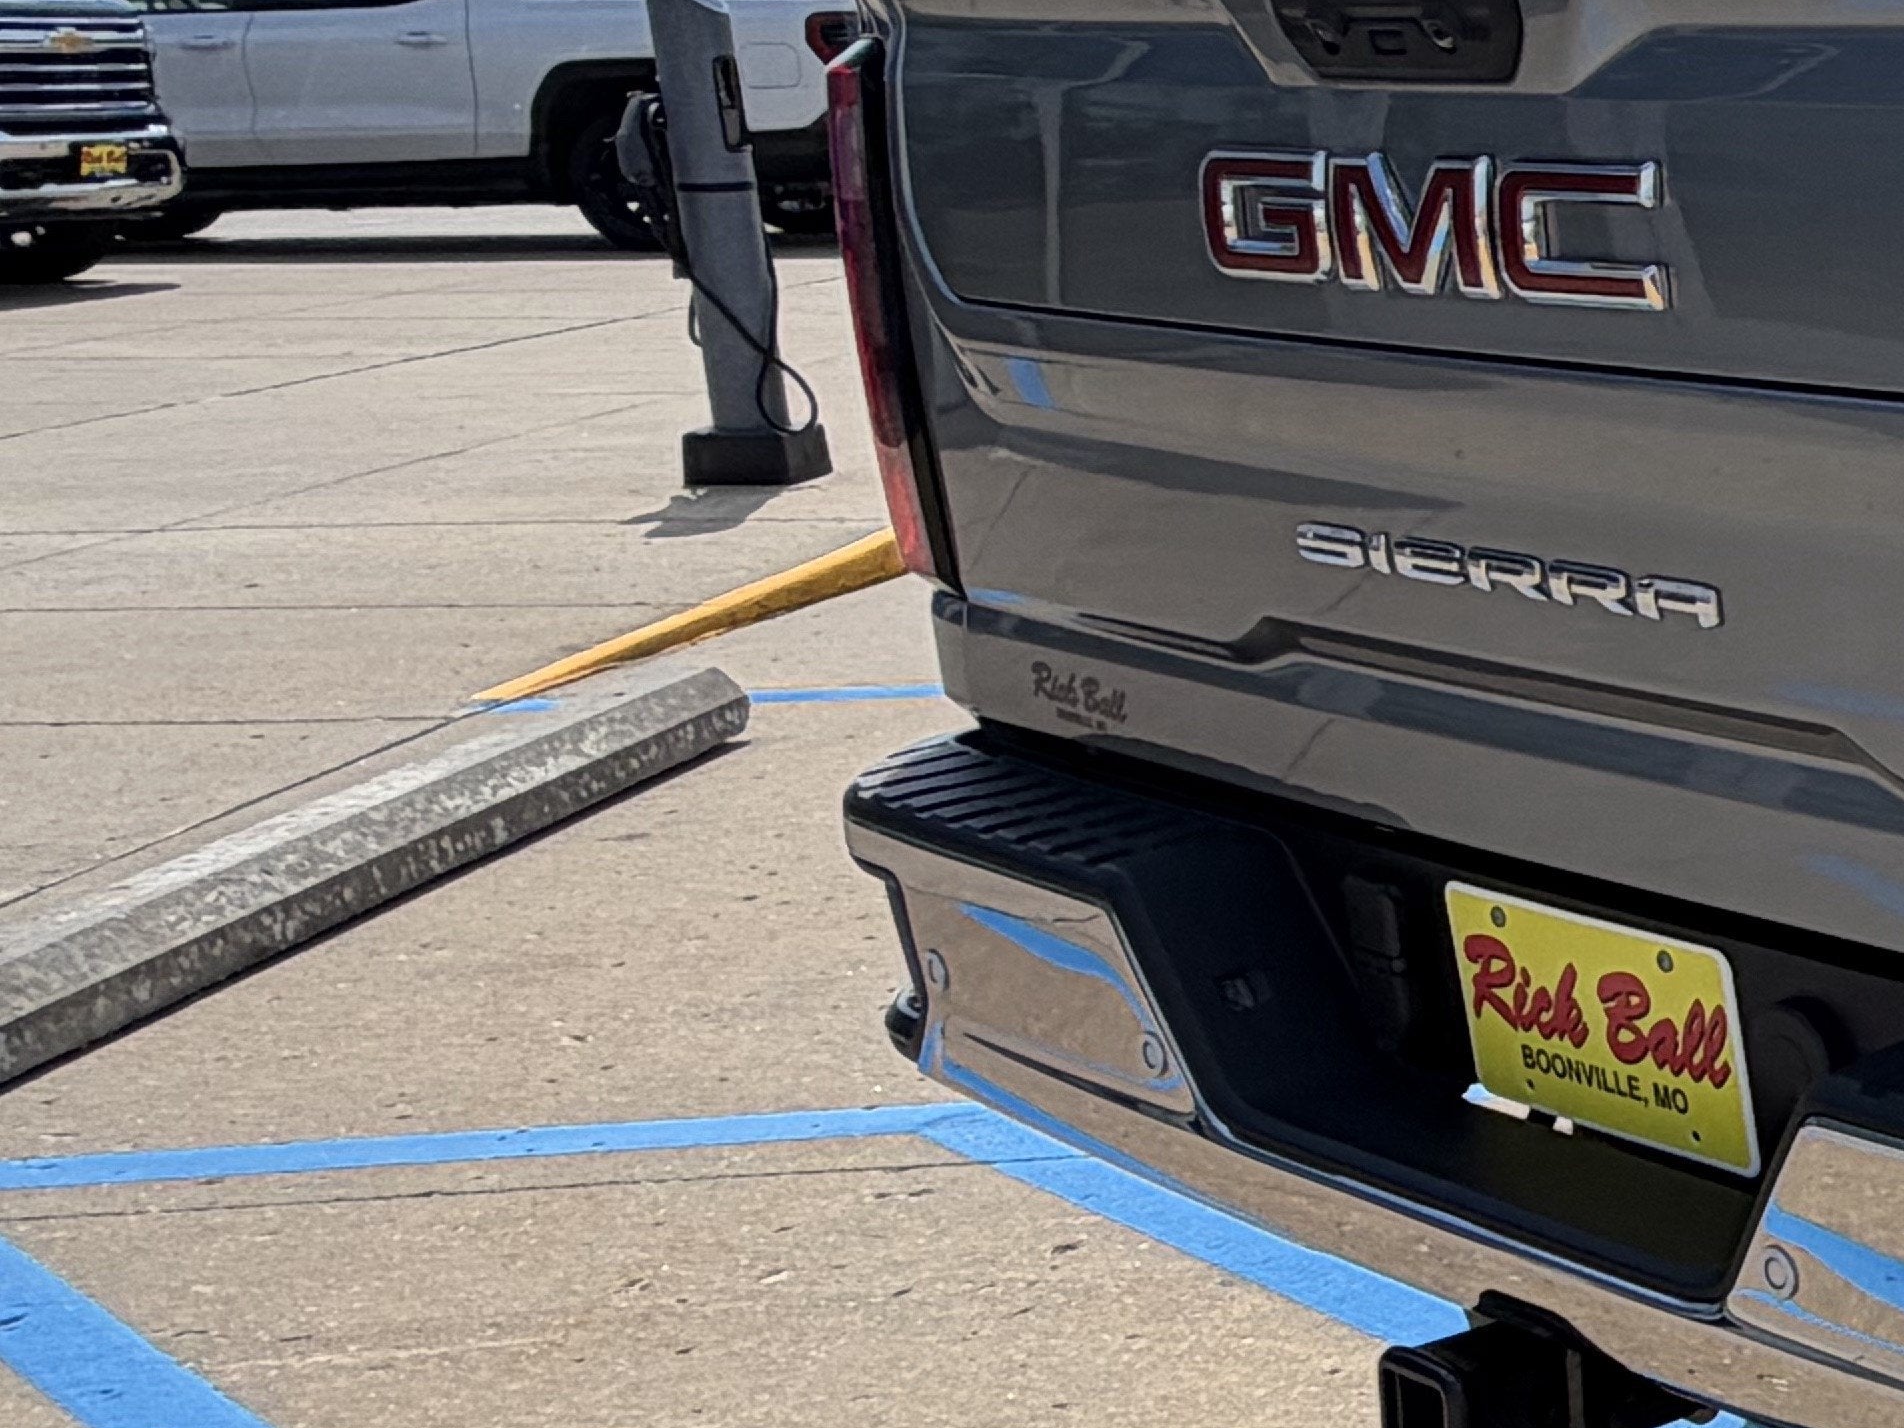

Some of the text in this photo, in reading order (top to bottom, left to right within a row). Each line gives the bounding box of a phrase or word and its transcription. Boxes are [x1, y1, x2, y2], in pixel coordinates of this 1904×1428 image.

[1200, 148, 1670, 310] GMC
[1295, 520, 1724, 629] SIERRA
[1463, 934, 1731, 1089] Rick Ball
[1520, 1044, 1689, 1115] BOONVILLE, MO
